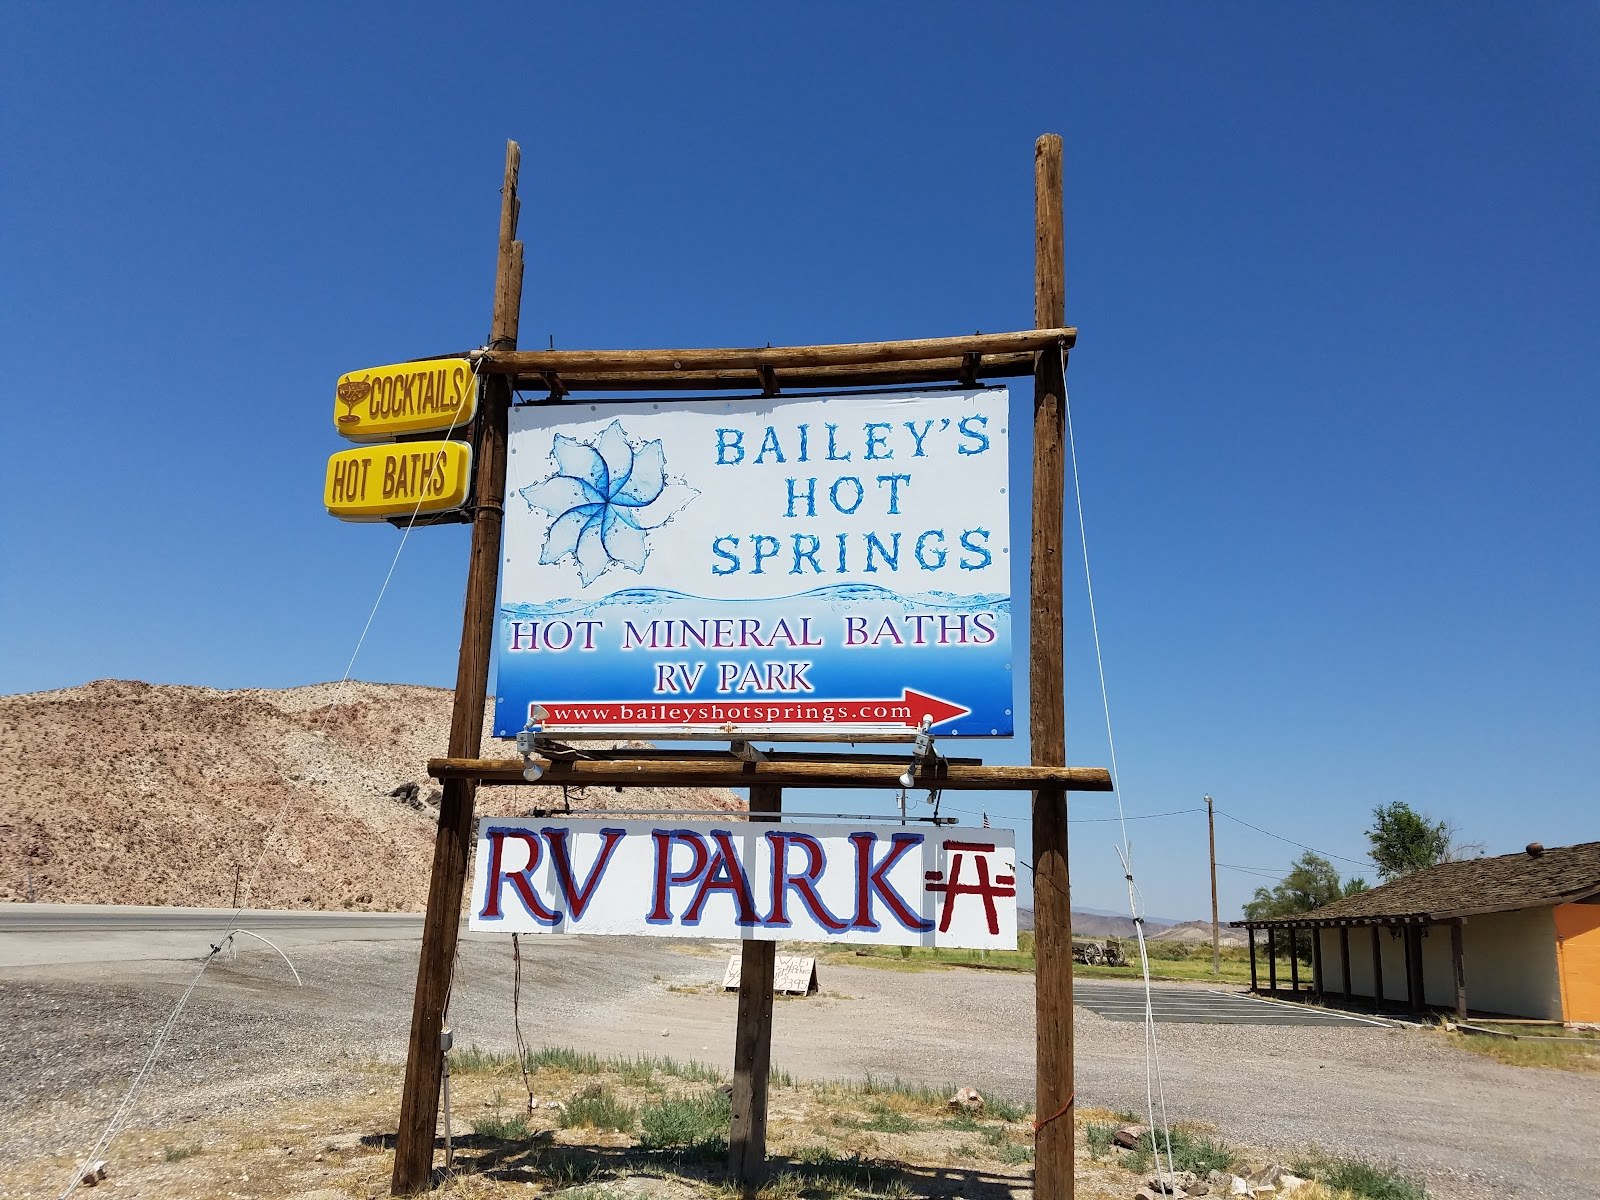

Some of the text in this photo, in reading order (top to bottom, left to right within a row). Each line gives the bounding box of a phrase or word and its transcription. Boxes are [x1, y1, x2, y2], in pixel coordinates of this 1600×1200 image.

[368, 367, 464, 419] COCKTAILS
[714, 413, 990, 466] BAILEY'S
[332, 451, 447, 502] HOT BATHS
[782, 472, 911, 518] HOT
[711, 526, 992, 577] SPRINGS
[510, 613, 996, 650] HOT MINERAL BATHS
[656, 663, 812, 692] RV PARK
[554, 704, 912, 723] www.baileyshotsprings.com
[478, 826, 936, 934] RV PARK
